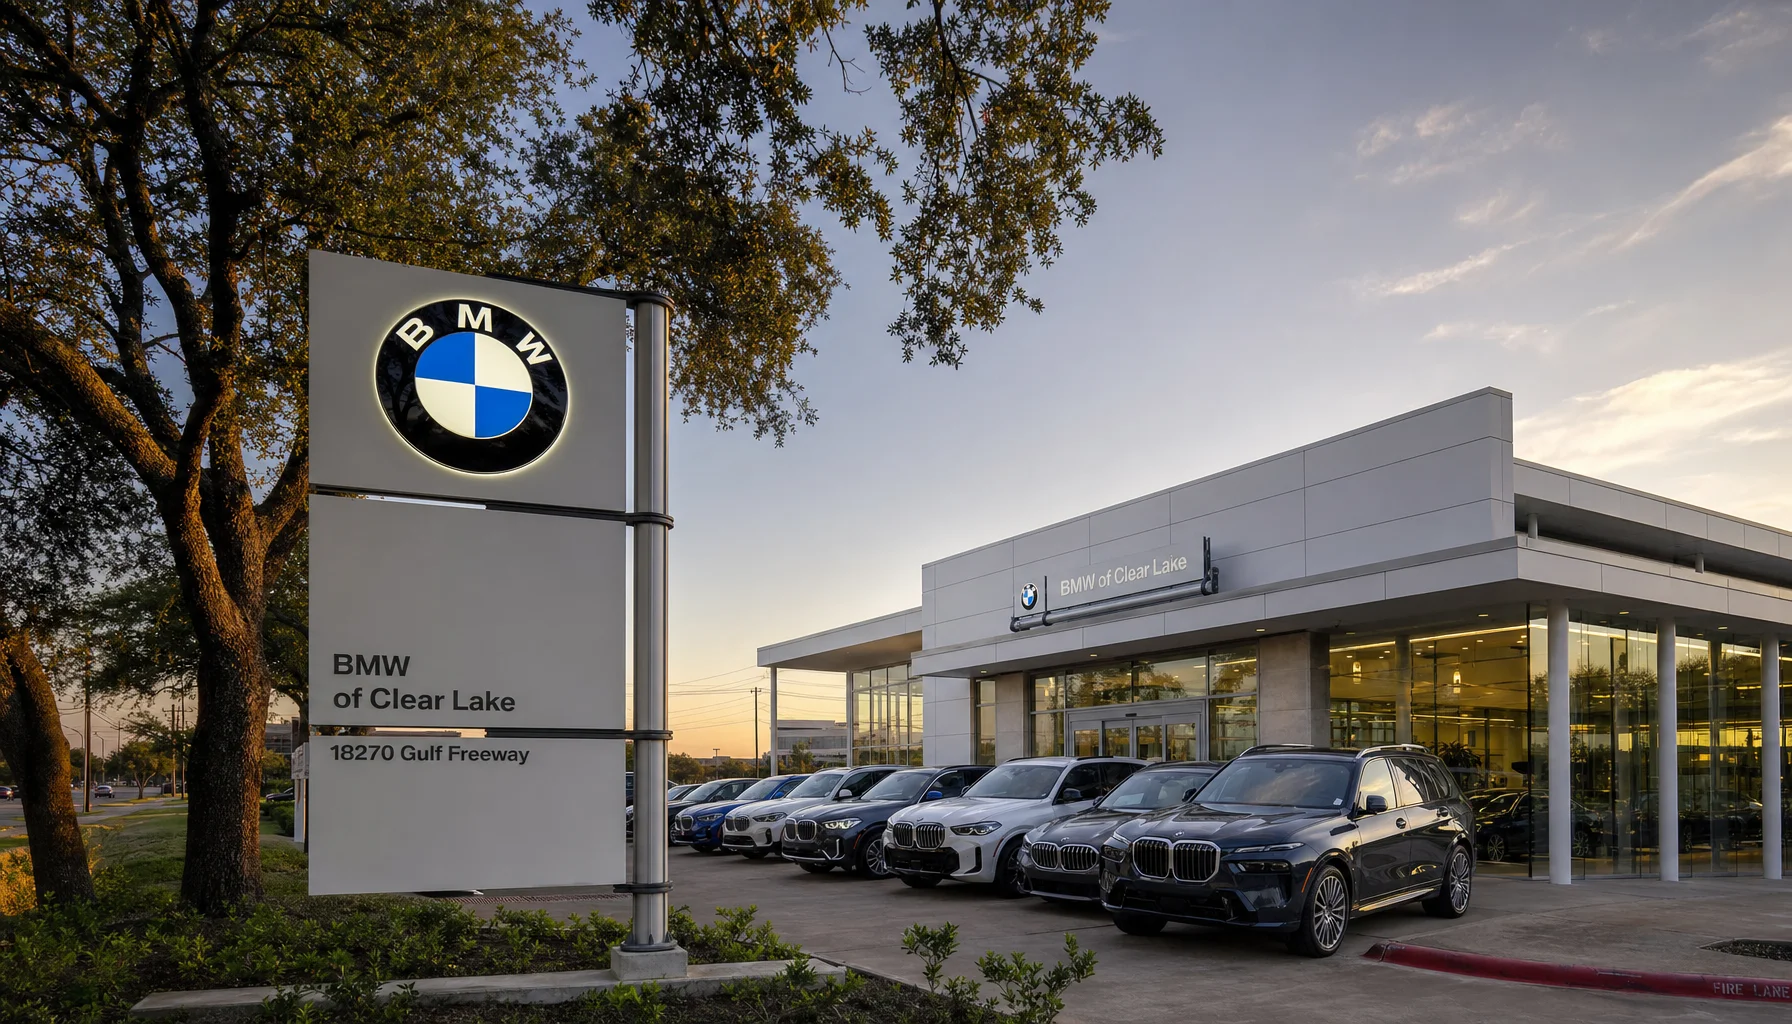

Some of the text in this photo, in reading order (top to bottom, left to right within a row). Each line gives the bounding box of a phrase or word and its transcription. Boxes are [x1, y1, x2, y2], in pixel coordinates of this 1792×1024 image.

[396, 303, 553, 366] BMW
[1060, 556, 1187, 596] BMW of Clear Lake
[333, 653, 411, 677] BMW
[333, 687, 516, 712] of Clear Lake
[329, 744, 530, 765] 18270 Gulf Freeway
[1713, 982, 1790, 998] FIRE LANE
